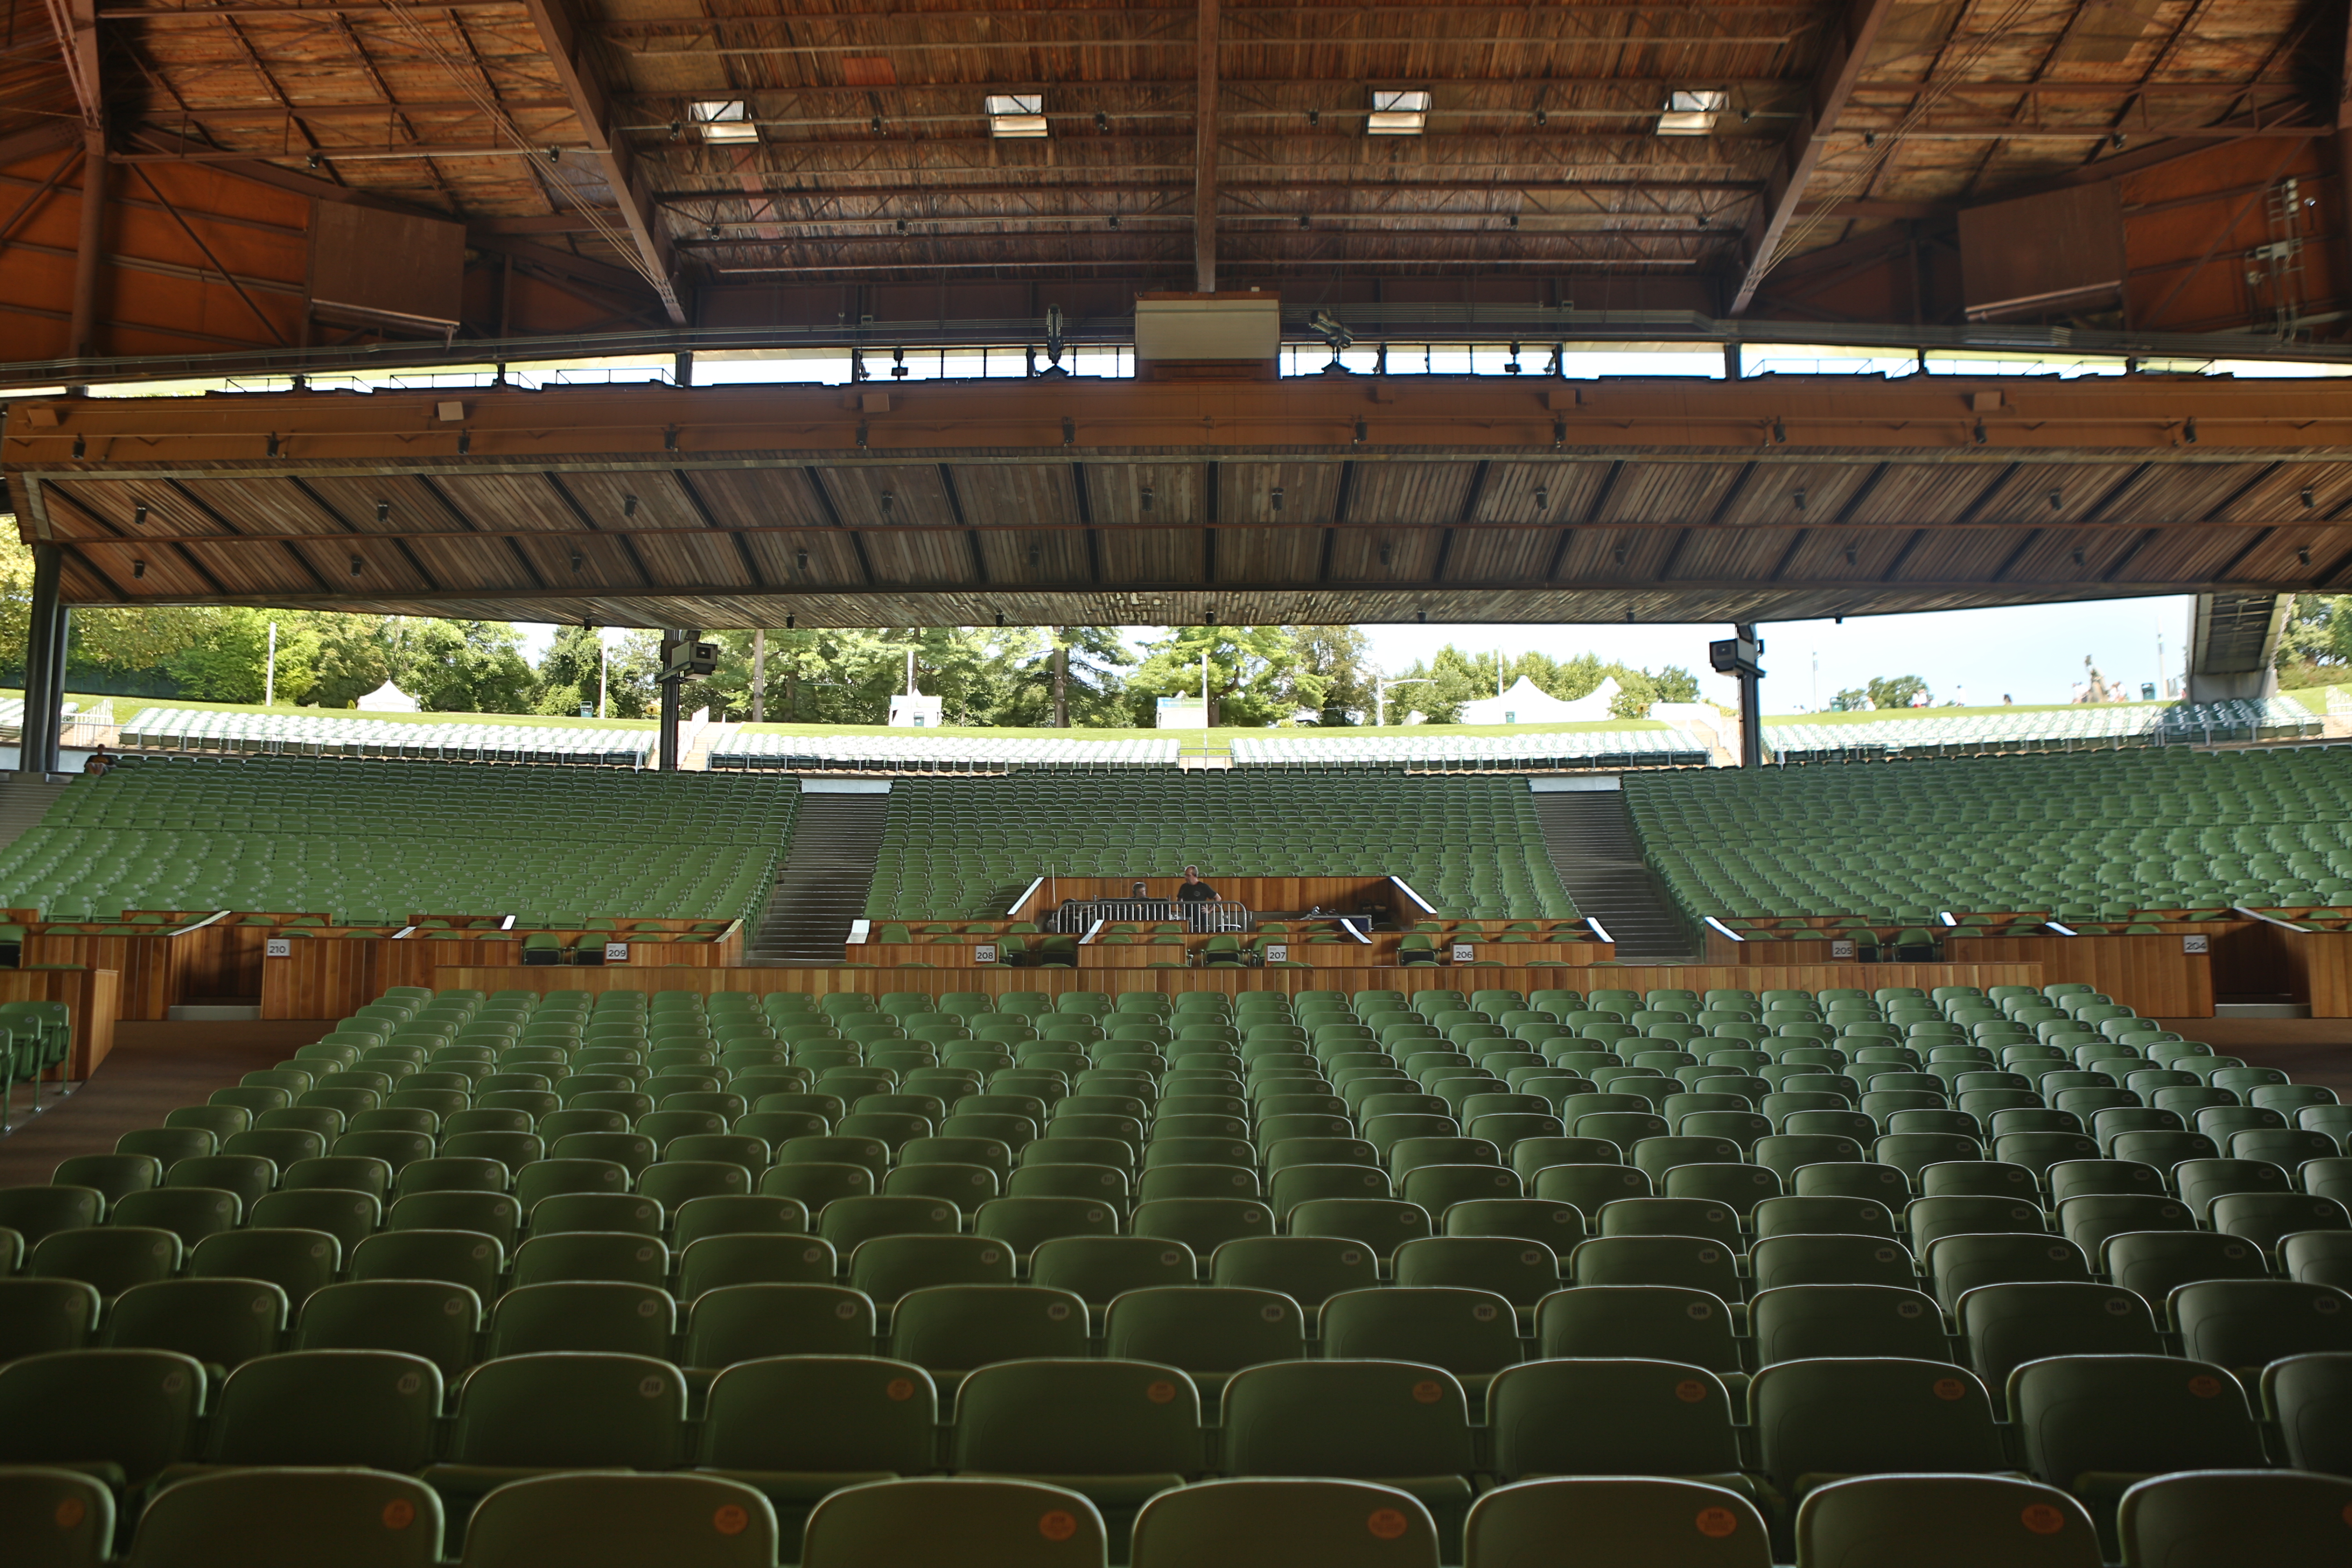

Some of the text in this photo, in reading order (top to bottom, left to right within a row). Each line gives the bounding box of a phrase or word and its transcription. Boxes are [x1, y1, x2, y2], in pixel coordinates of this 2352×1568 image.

[1902, 1305, 1918, 1313] 205
[2110, 1302, 2126, 1310] 204
[2319, 1301, 2335, 1309] 203
[1478, 1308, 1492, 1316] 207
[1693, 1307, 1707, 1315] 206
[403, 1378, 416, 1388] 211
[645, 1381, 661, 1392] 210
